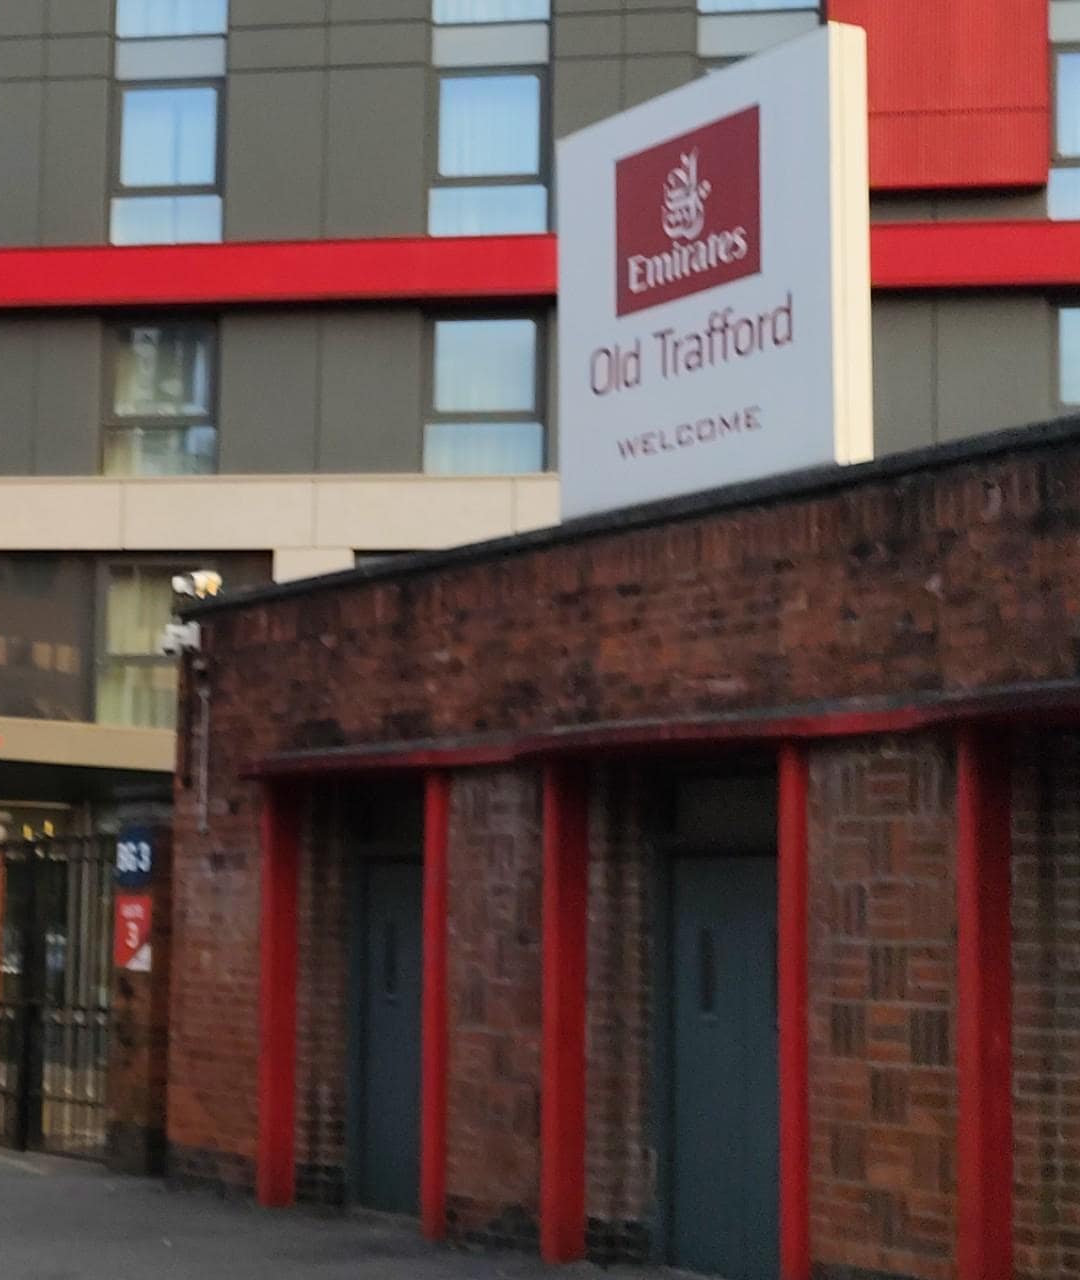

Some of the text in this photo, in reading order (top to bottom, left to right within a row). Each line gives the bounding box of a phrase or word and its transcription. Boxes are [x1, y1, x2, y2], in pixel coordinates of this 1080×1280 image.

[626, 225, 749, 294] Emirates
[589, 292, 794, 397] Old Trafford
[616, 405, 763, 462] WELCOME
